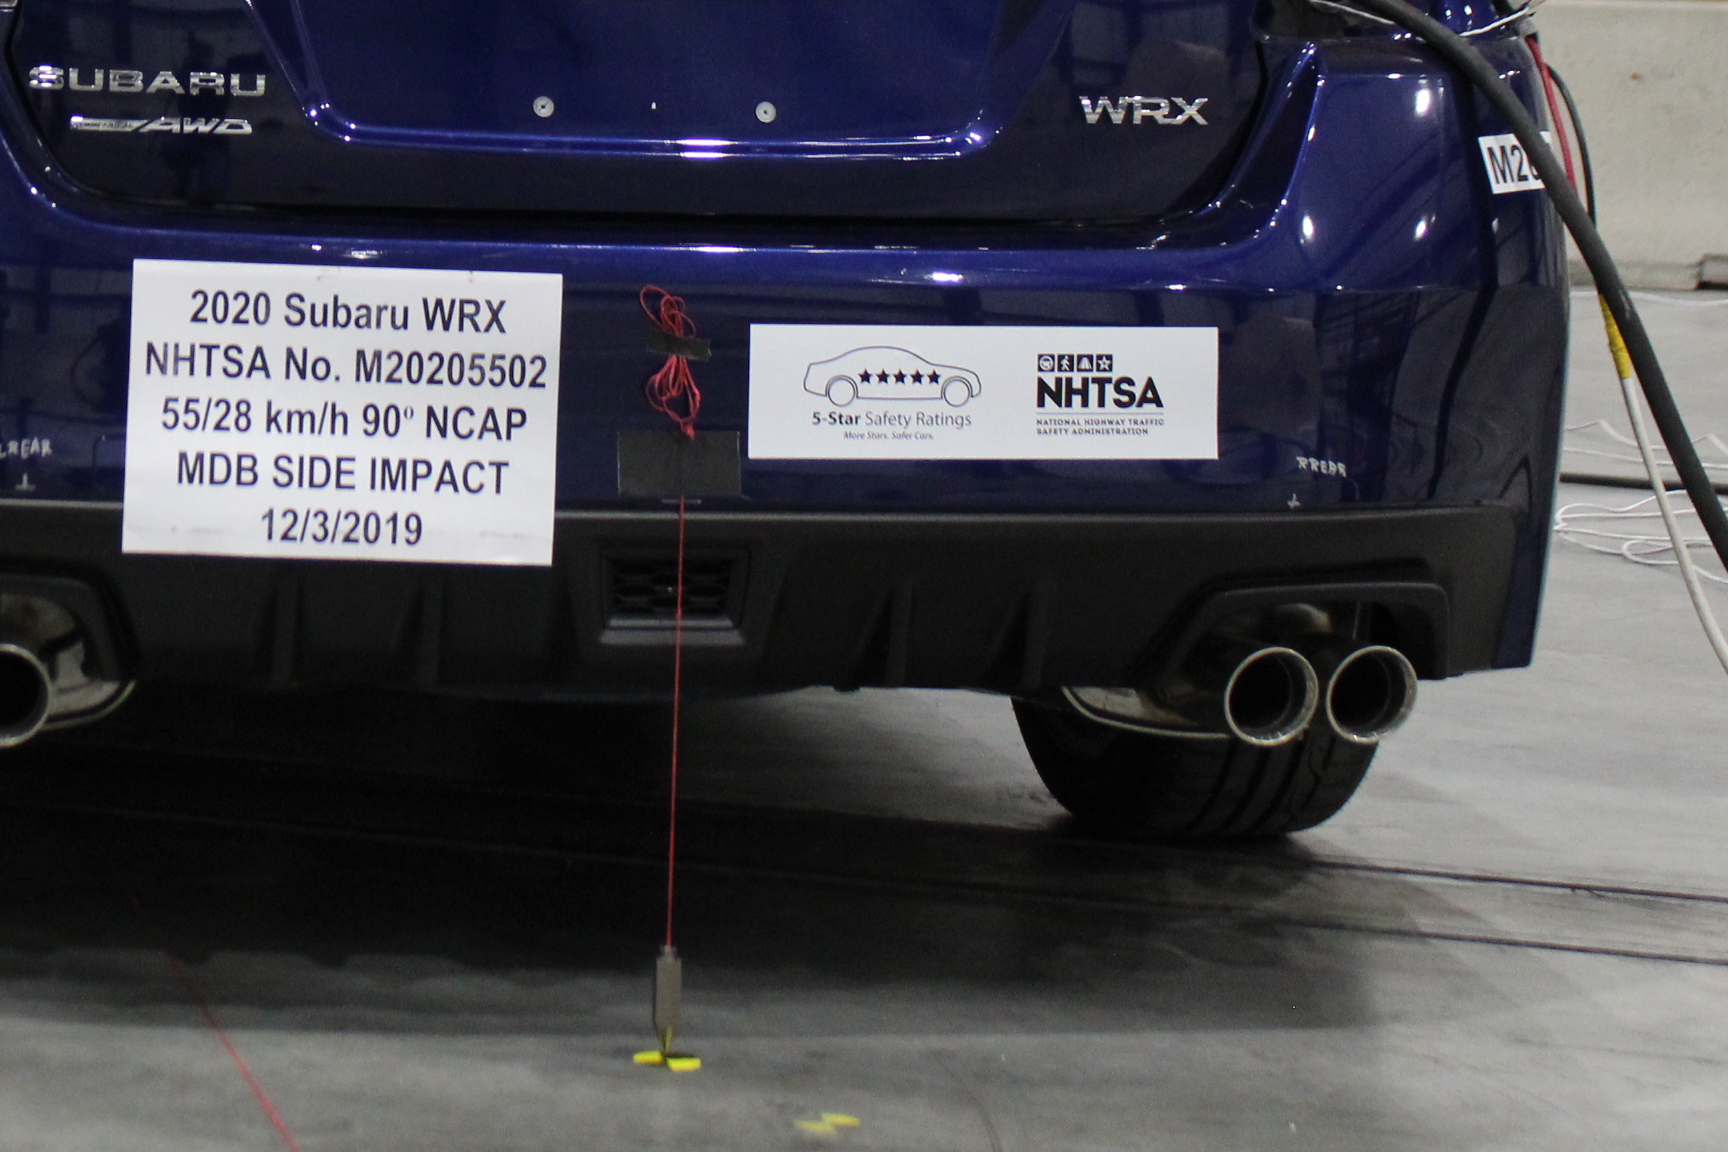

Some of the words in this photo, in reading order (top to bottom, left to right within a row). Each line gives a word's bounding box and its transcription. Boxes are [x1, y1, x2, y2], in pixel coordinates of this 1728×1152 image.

[29, 65, 266, 97] SUBARU
[137, 115, 253, 135] AWD
[1079, 95, 1209, 125] WRX
[190, 289, 271, 326] 2020
[284, 292, 409, 331] Subaru
[422, 297, 506, 334] WRX
[145, 341, 271, 379] NHTSA
[285, 346, 340, 382] No.
[355, 349, 547, 389] M20205502
[1036, 376, 1164, 409] NHTSA
[162, 397, 252, 433] 55/28
[265, 399, 349, 436] km/h
[425, 405, 527, 441] NCAP
[812, 411, 861, 426] 5-Star
[865, 411, 912, 429] Safety
[916, 411, 972, 430] Ratings
[843, 431, 866, 440] More
[867, 431, 889, 440] Stars.
[891, 430, 912, 440] Safer
[913, 430, 935, 440] Cars.
[1036, 418, 1081, 426] NATIONAL
[1084, 418, 1125, 426] HIGHWAY
[1128, 418, 1164, 426] TRAFFIC
[1036, 427, 1069, 435] SAFETY
[1071, 427, 1149, 436] ADMINISTRATION
[177, 451, 259, 487] MDB
[272, 454, 356, 490] SIDE
[370, 457, 510, 495] IMPACT
[261, 508, 423, 546] 12/3/2019
